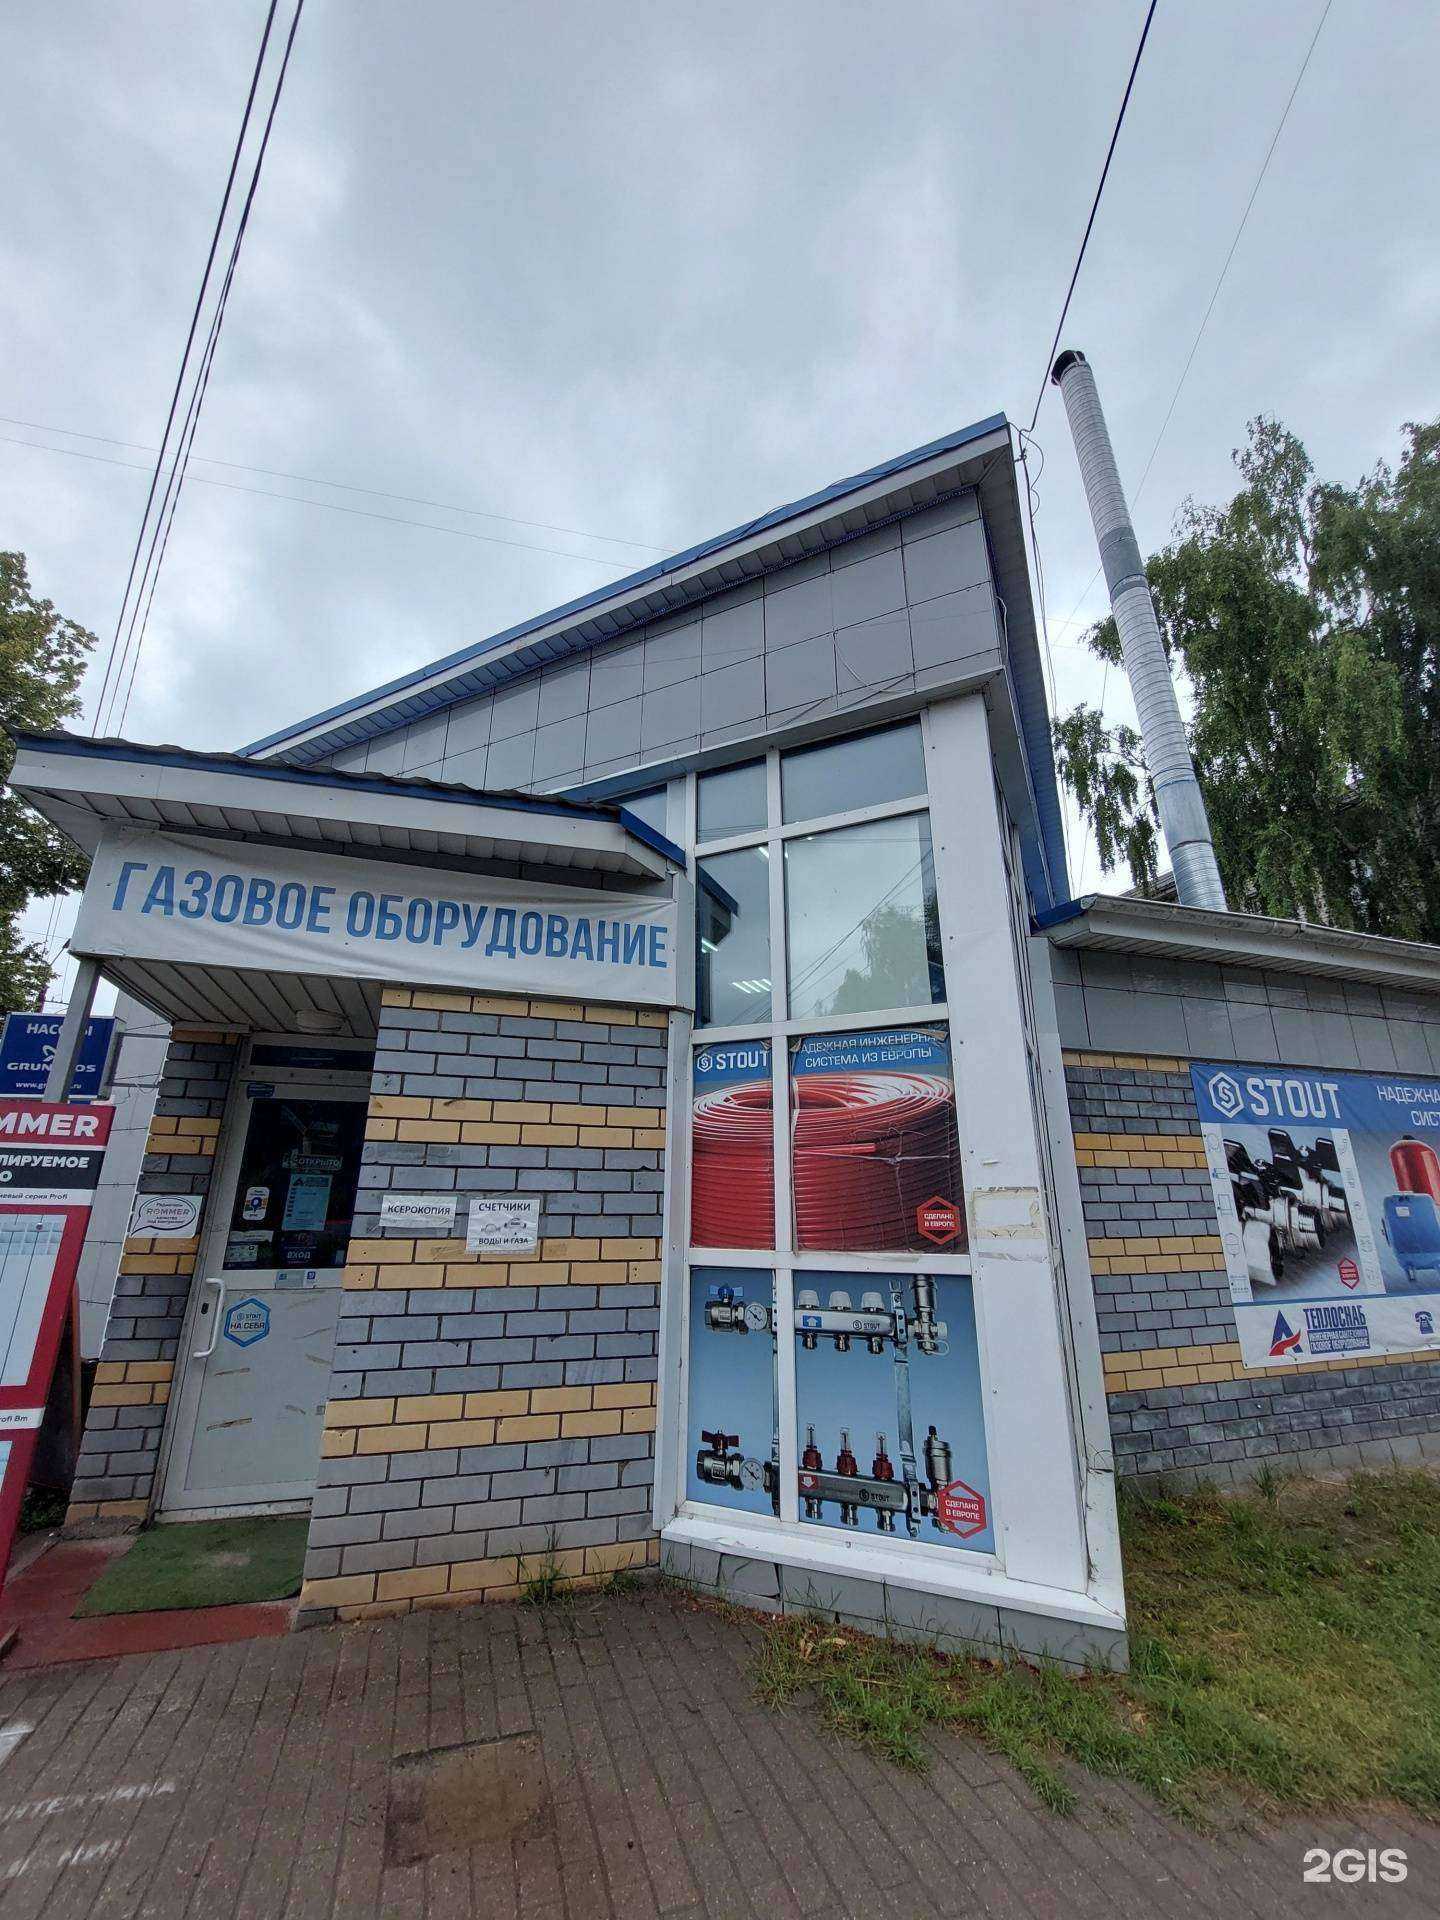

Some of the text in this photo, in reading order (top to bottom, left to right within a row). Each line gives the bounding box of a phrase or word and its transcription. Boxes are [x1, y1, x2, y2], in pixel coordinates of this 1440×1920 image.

[111, 861, 668, 969] ГАЗОВОЕ ОБОРУДОВАНИЕ
[801, 1033, 936, 1054] АДЕЖНАЯ ИНЖЕНЕРНА
[716, 1050, 770, 1070] STOUT
[805, 1047, 932, 1068] СИСТЕМА ИЗ ЕВРОПЫ
[7, 1062, 97, 1073] GRUNOS
[1246, 1077, 1341, 1119] STOUT
[387, 1204, 451, 1216] КСЕРОКОПИЯ
[478, 1202, 531, 1212] СЧЕТЧИКИ
[478, 1237, 502, 1246] ВОДЫ
[510, 1237, 529, 1245] ГАЗА
[1303, 1304, 1367, 1330] ТЕПЛОСНАБ
[244, 1322, 265, 1330] СЕБЯ
[863, 1322, 881, 1330] STOUT
[945, 1499, 979, 1511] СДЕЛАНО
[945, 1510, 980, 1520] В ЕВРОПЕ
